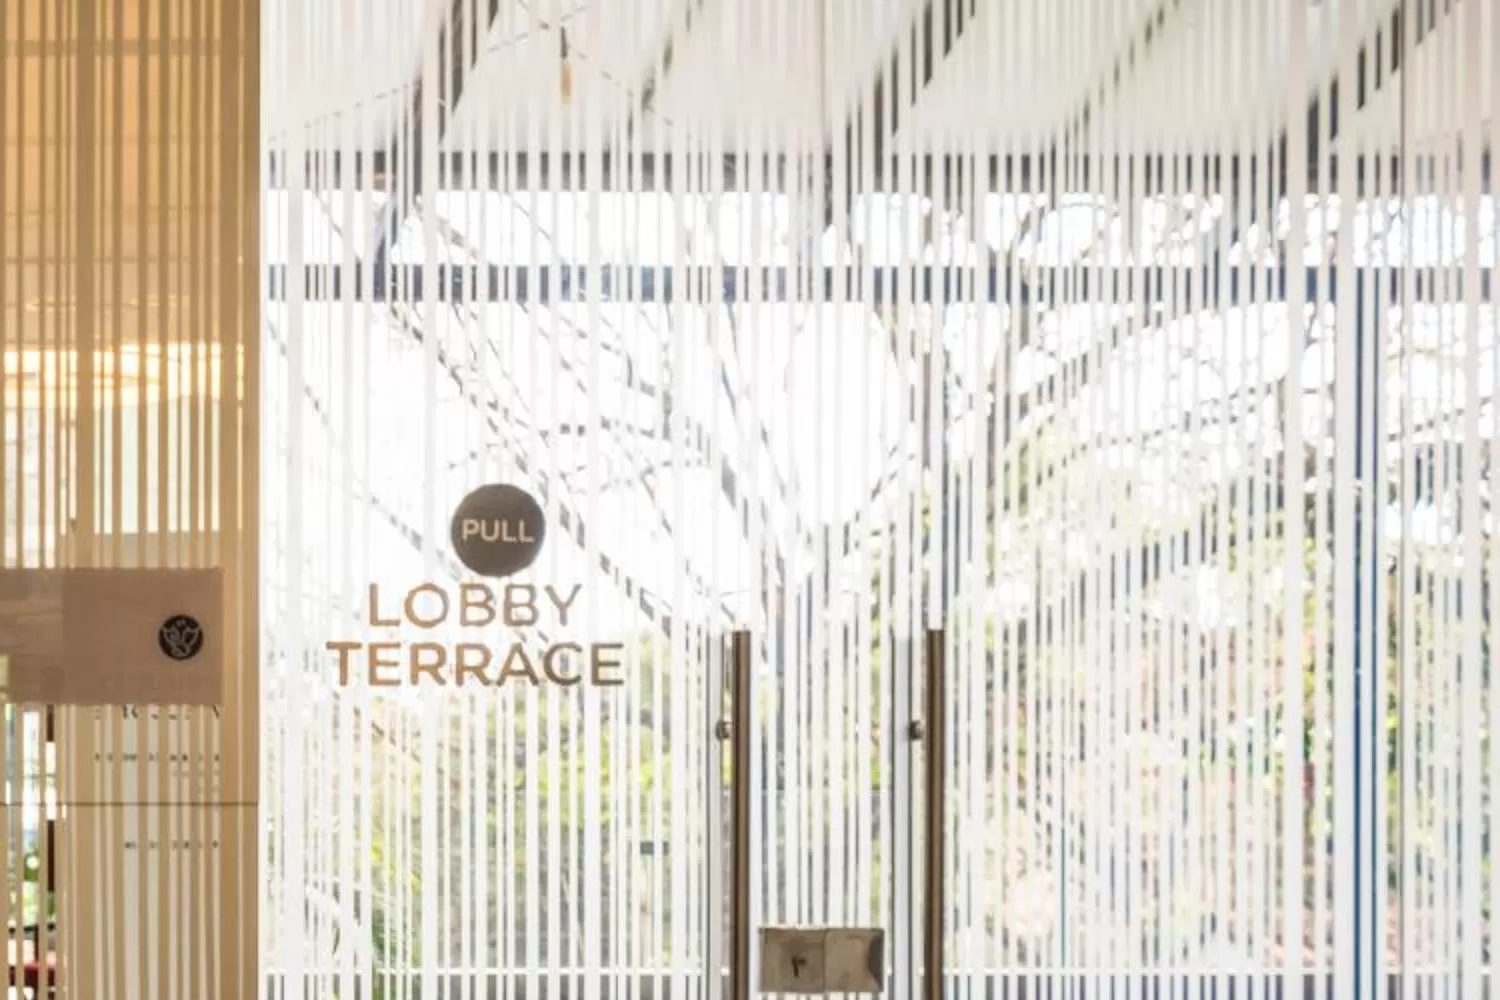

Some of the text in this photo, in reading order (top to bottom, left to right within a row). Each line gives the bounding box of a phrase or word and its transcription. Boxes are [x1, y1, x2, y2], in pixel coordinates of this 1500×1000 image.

[461, 518, 535, 543] PULL
[368, 583, 582, 628] LOBBY
[326, 641, 624, 686] TERRACE
